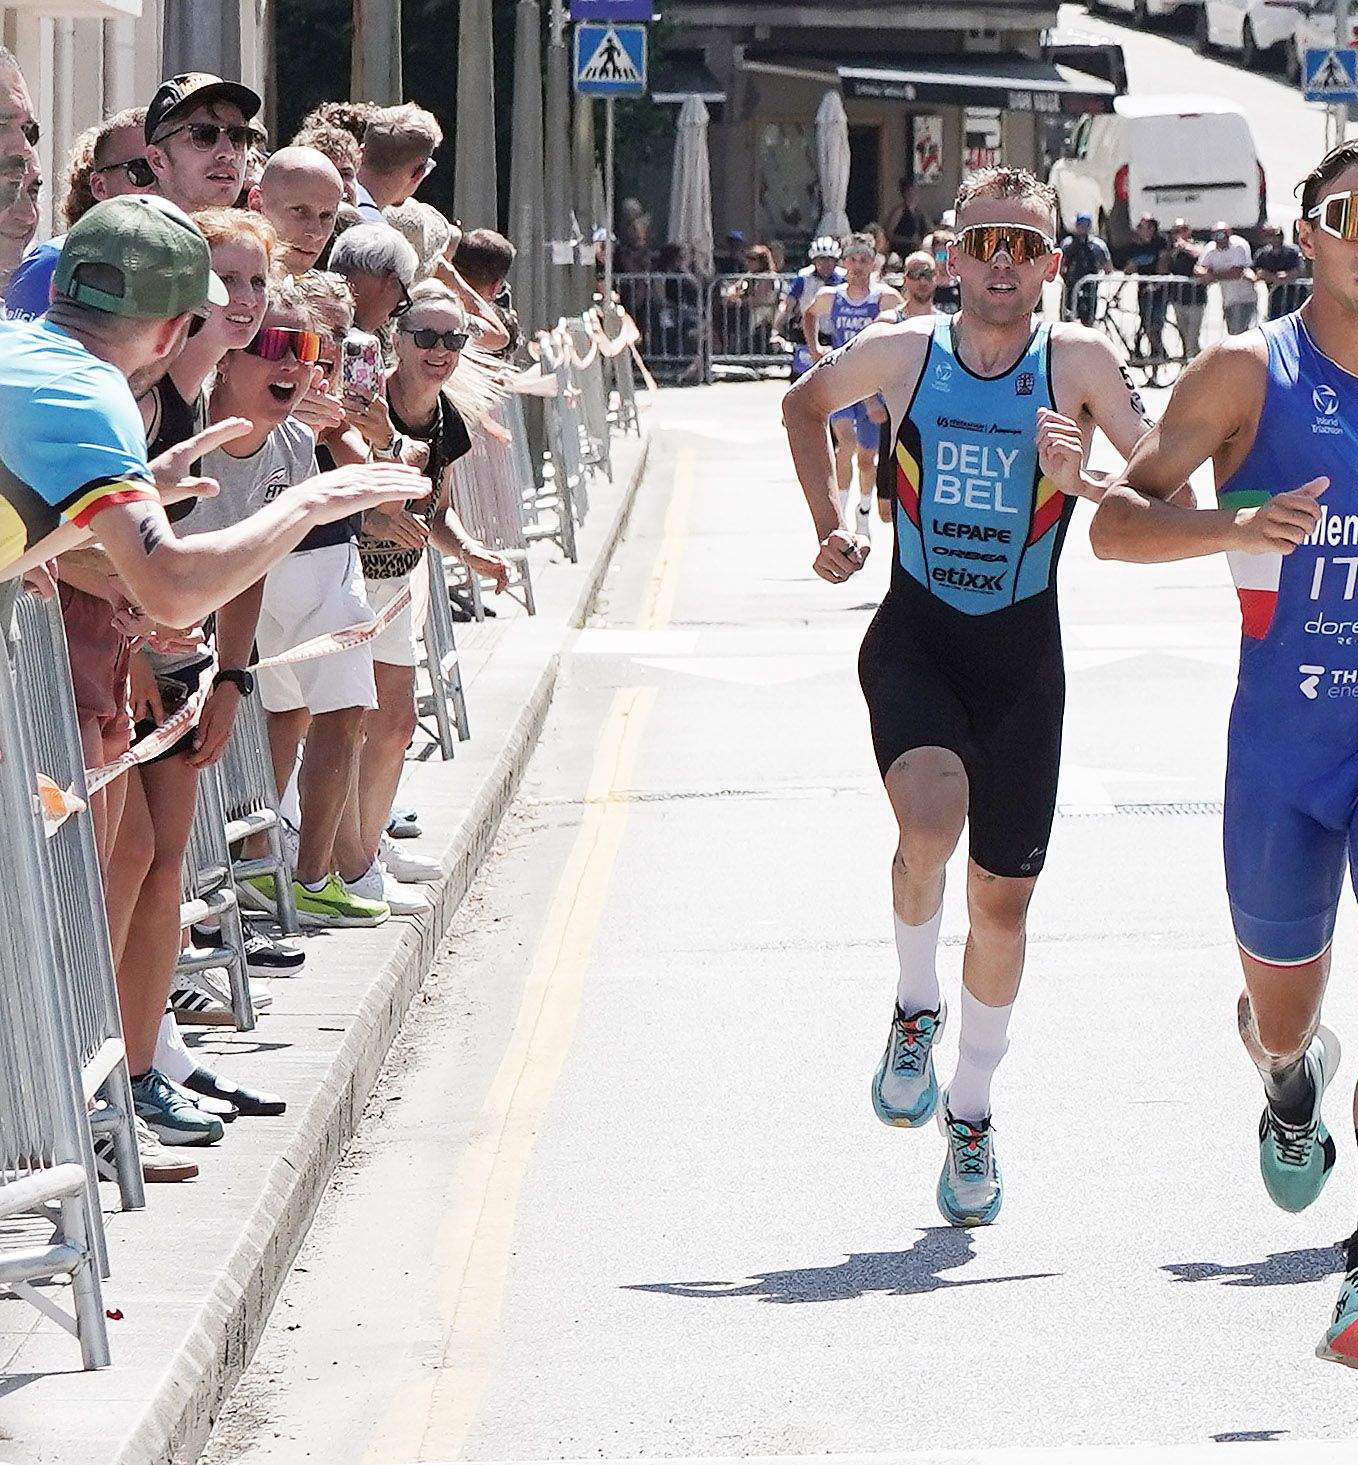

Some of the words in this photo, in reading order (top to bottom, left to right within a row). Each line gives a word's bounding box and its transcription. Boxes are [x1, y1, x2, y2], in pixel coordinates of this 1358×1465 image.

[936, 440, 1020, 479] DELY
[933, 473, 1019, 514] BEL
[932, 518, 1012, 544] LEPAPE
[932, 546, 1009, 563] ORBEA
